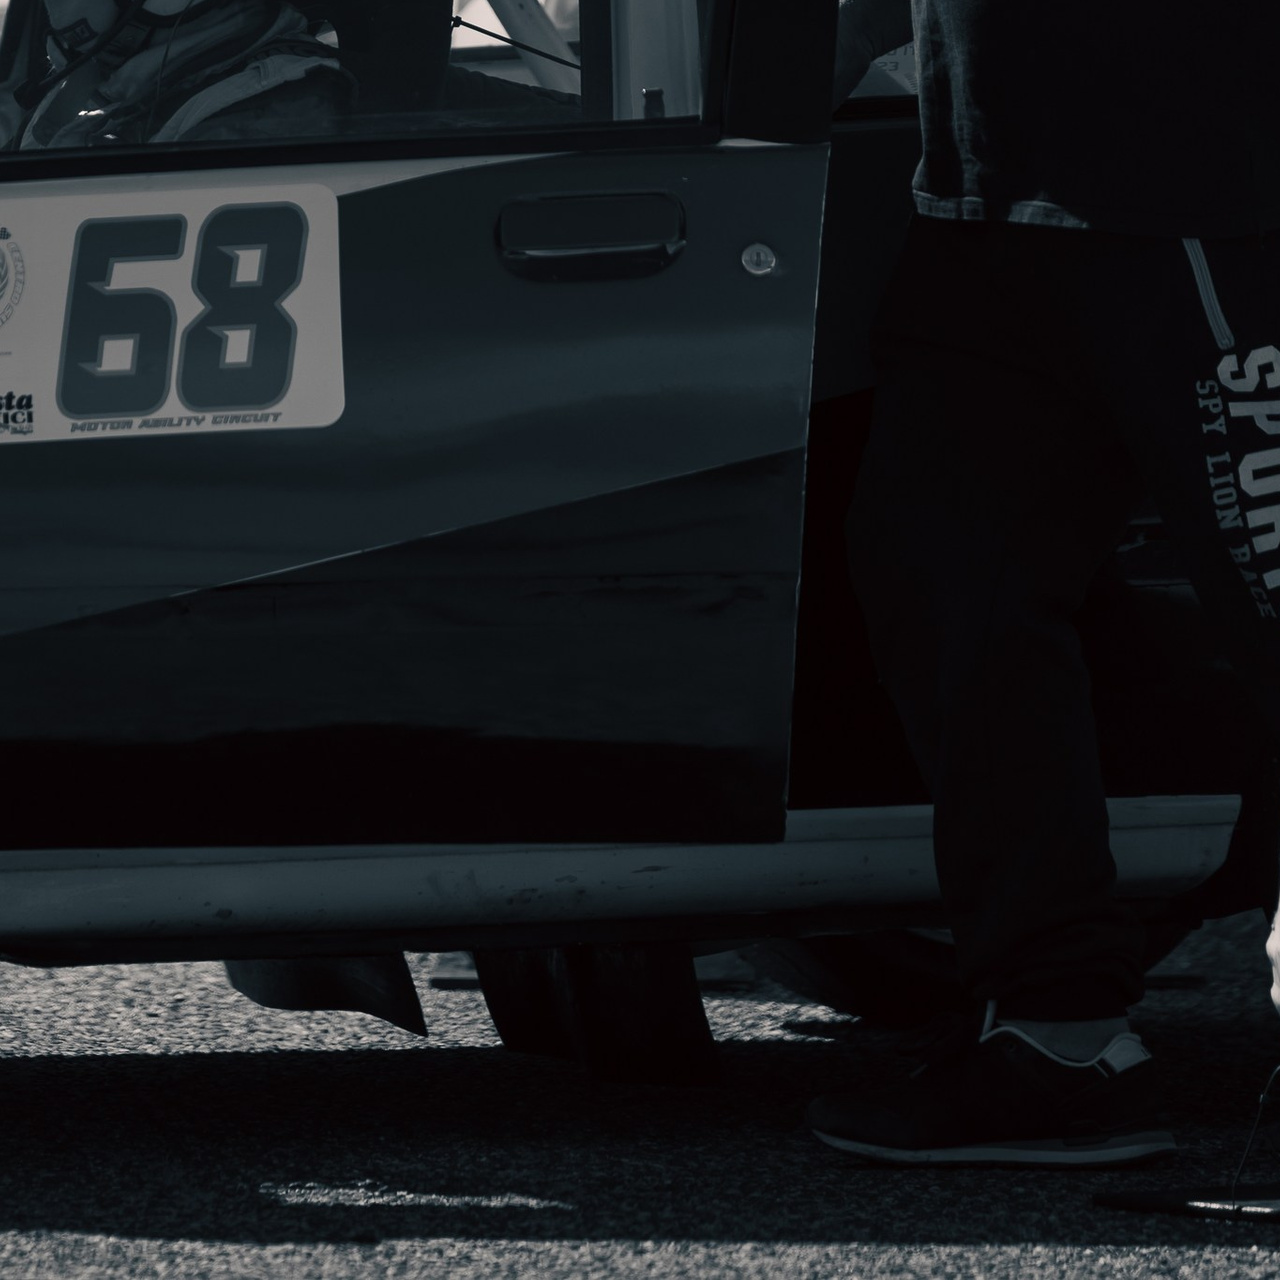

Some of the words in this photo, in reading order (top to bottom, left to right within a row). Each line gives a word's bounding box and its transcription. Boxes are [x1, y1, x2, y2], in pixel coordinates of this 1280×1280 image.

[55, 201, 310, 420] 68
[70, 419, 133, 434] MOTOR
[138, 415, 206, 429] ABILITY
[211, 411, 284, 425] CIRCUIT
[1195, 378, 1228, 436] SPY
[1205, 450, 1244, 531] LION
[1217, 344, 1280, 591] SPO
